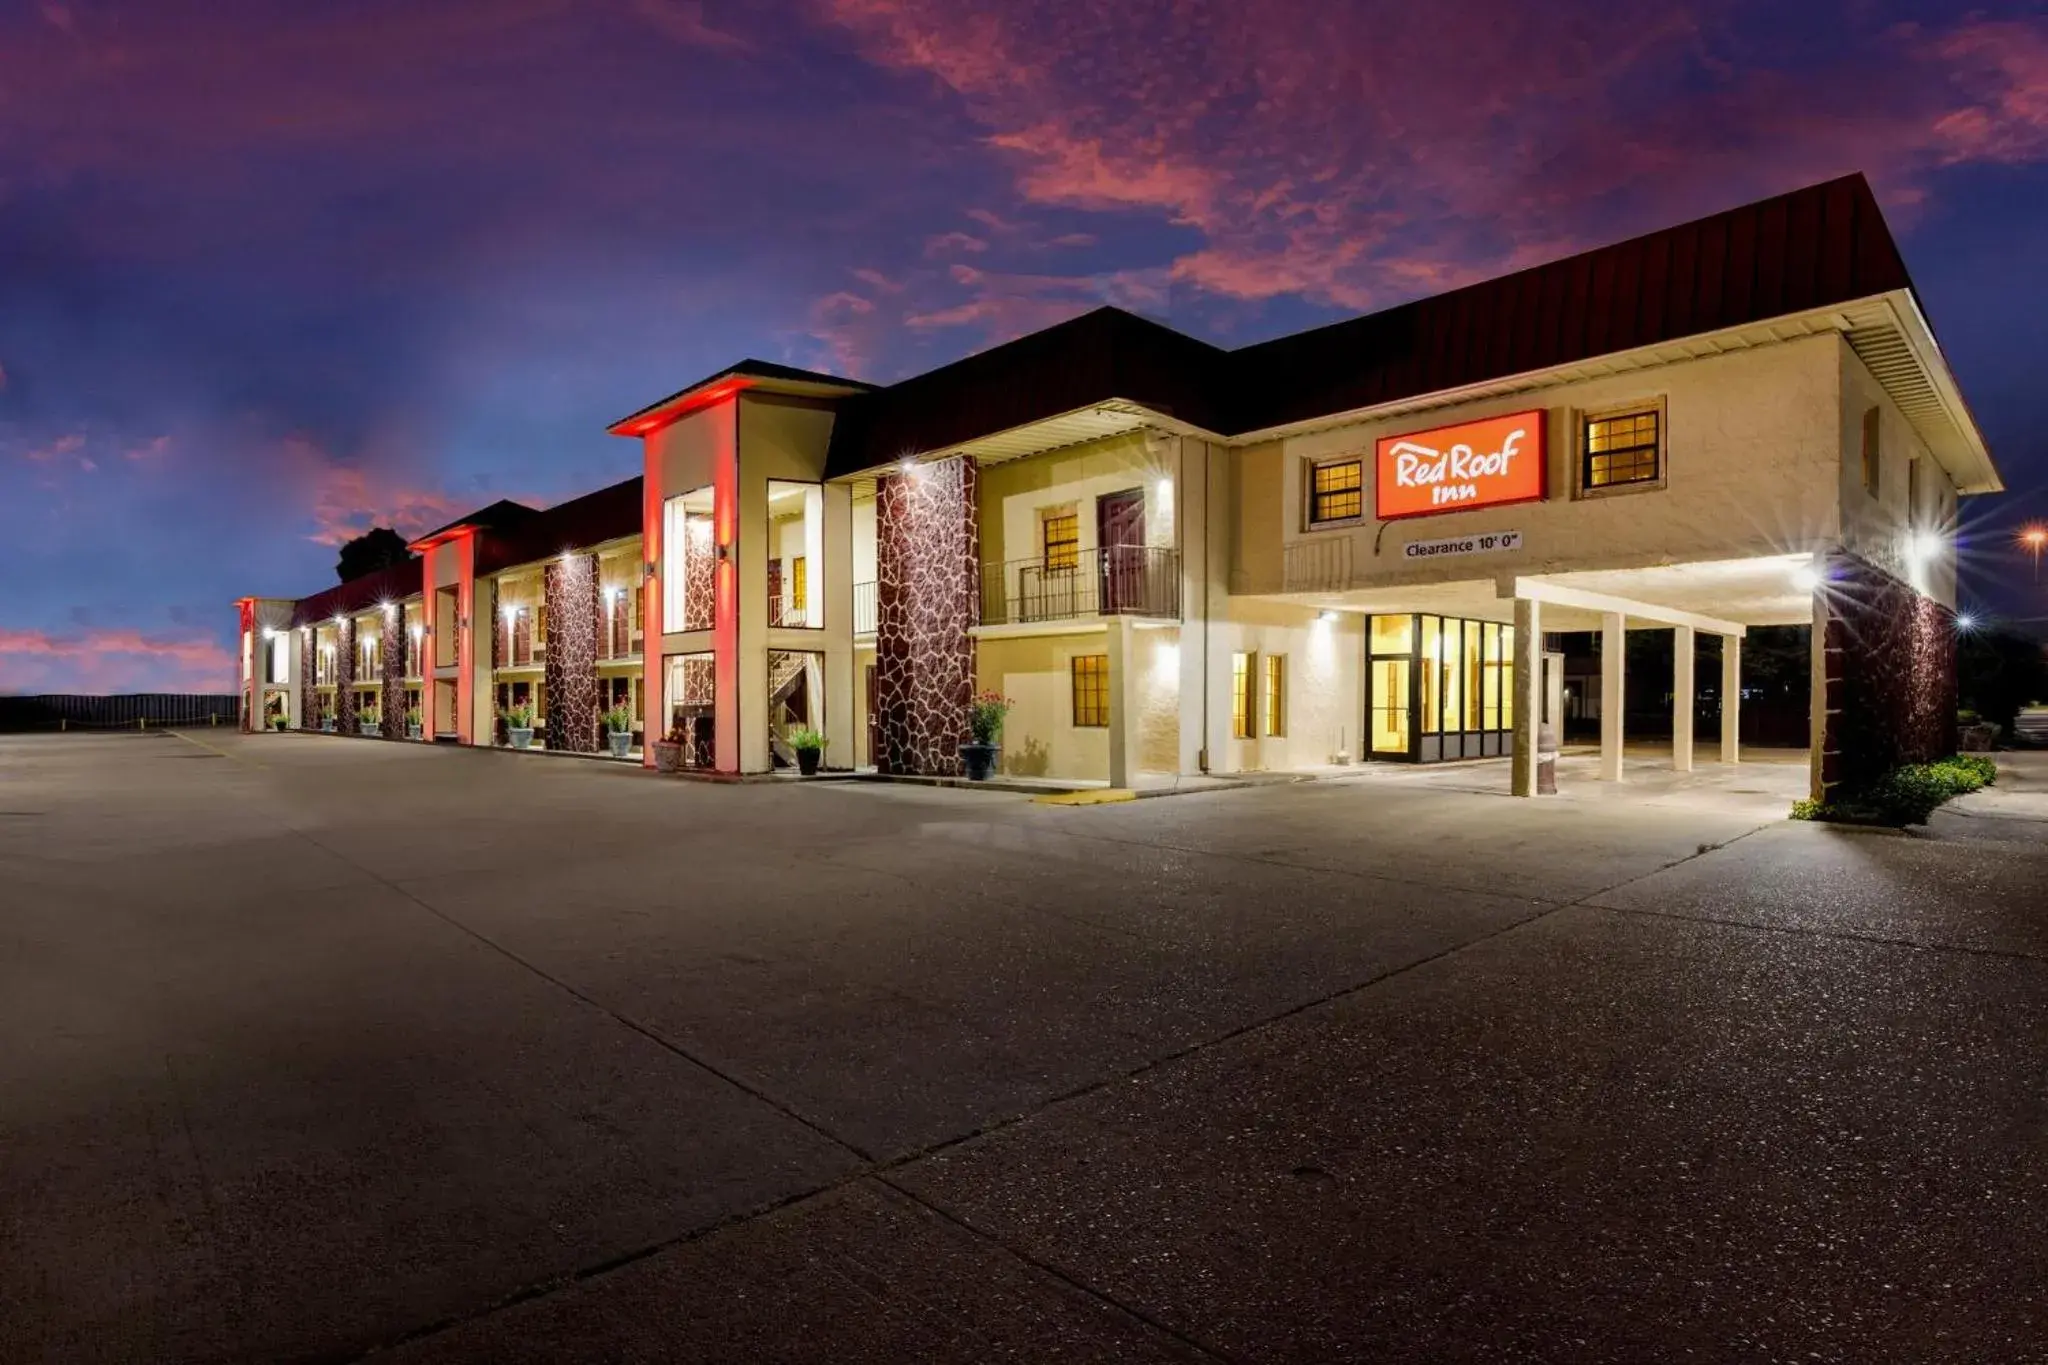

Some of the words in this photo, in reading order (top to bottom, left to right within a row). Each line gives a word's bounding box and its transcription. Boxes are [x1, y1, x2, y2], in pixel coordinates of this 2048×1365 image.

[1397, 453, 1448, 487] Red
[1450, 429, 1525, 480] Roof
[1406, 541, 1473, 557] Clearance
